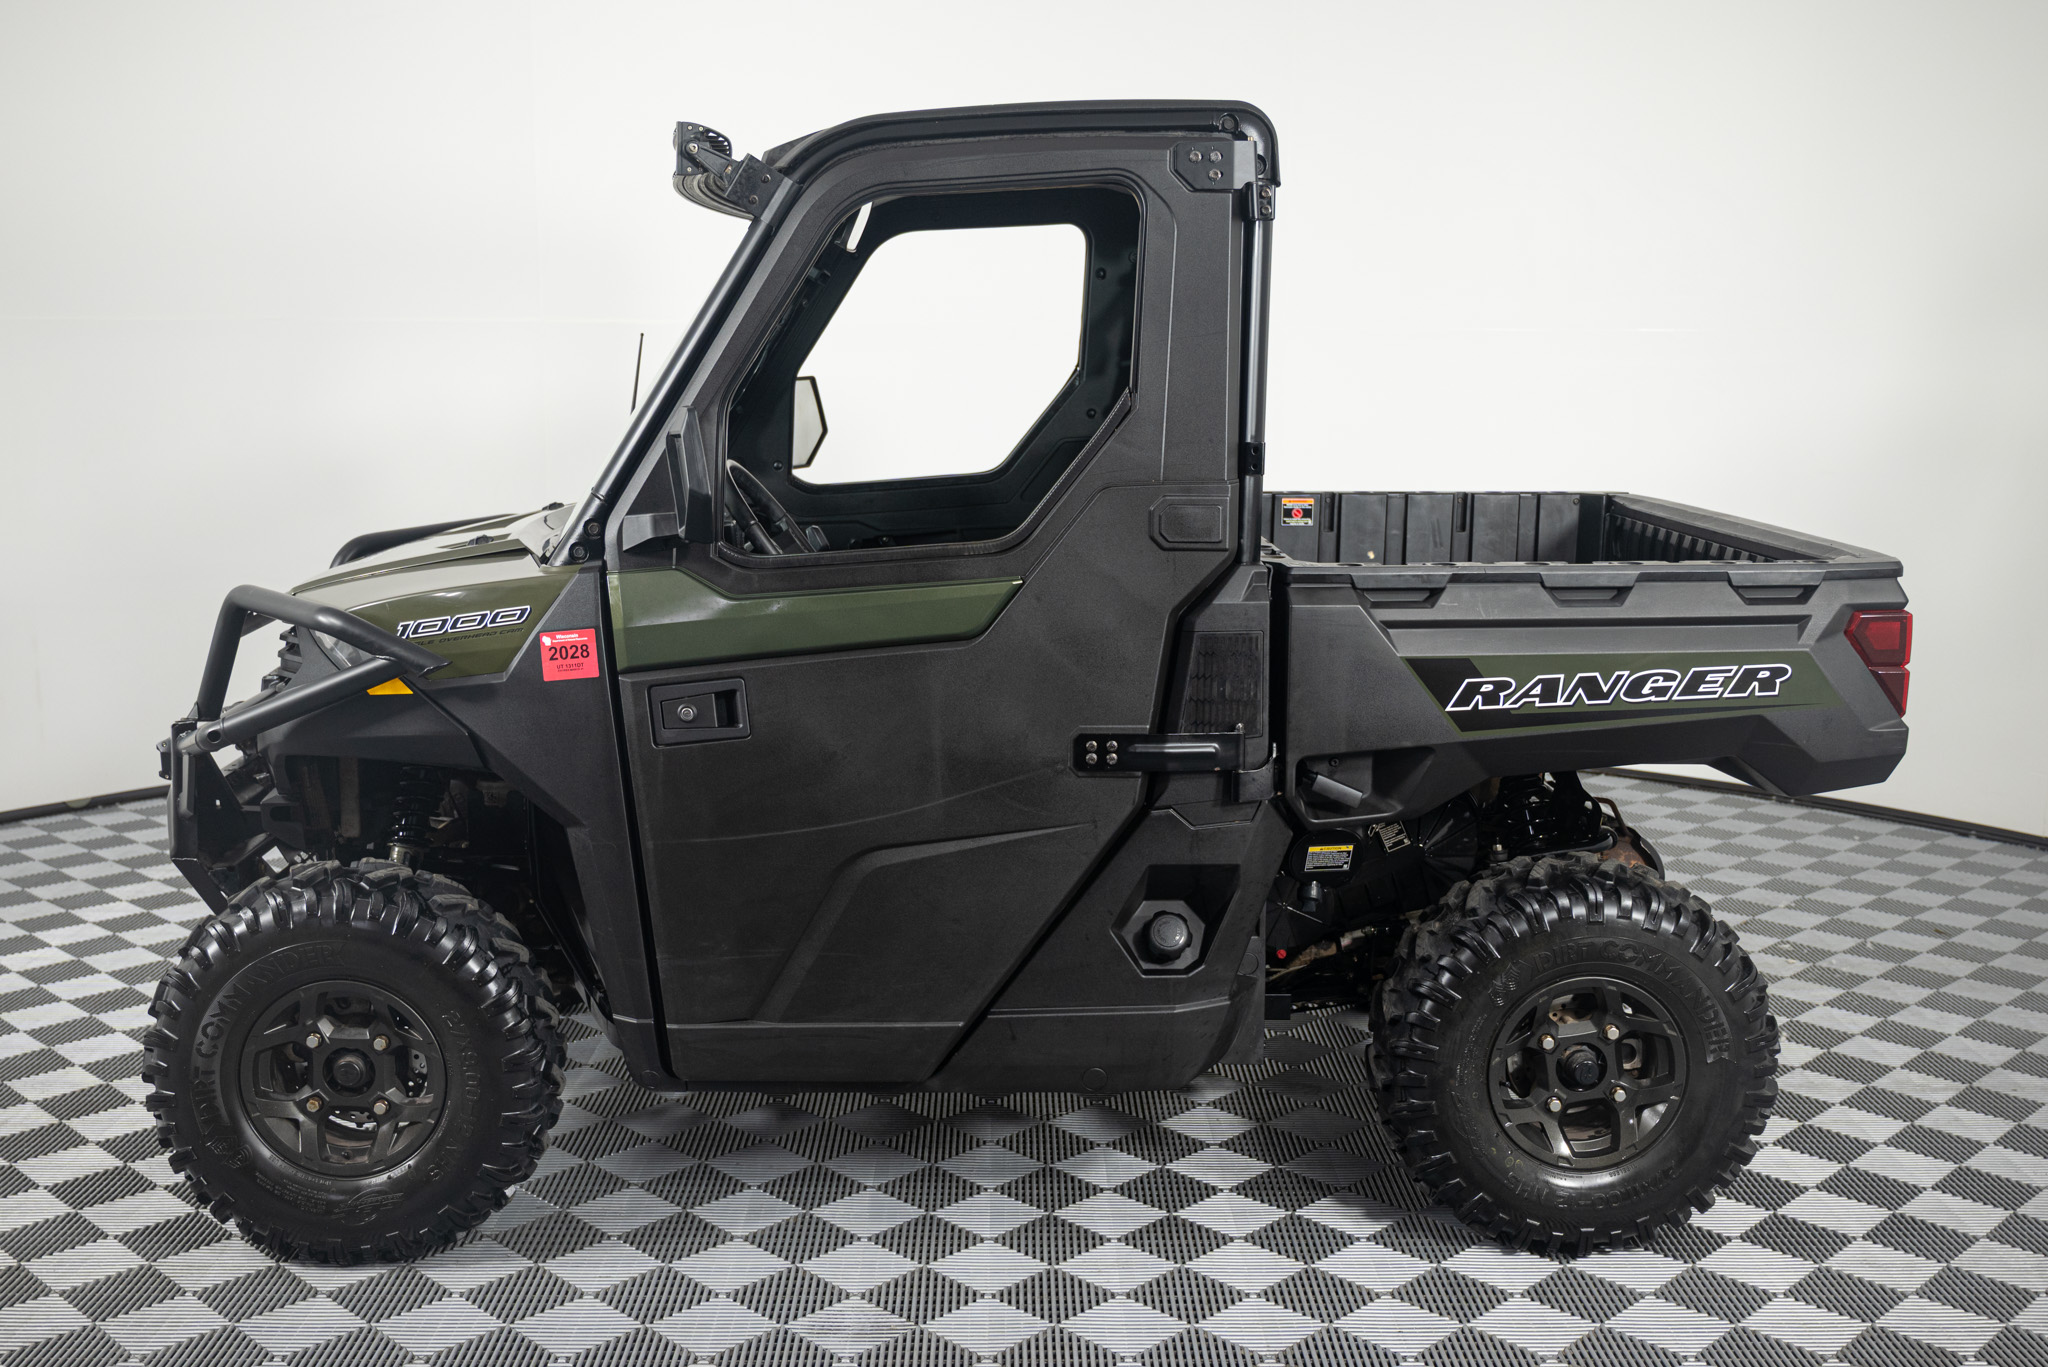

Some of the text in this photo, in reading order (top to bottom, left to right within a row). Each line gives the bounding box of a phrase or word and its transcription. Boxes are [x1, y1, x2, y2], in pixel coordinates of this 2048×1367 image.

[397, 605, 531, 639] 1000
[438, 631, 498, 643] OVERHEAD
[499, 627, 524, 635] CAM
[548, 644, 590, 661] 2028
[1445, 663, 1792, 711] RANGER
